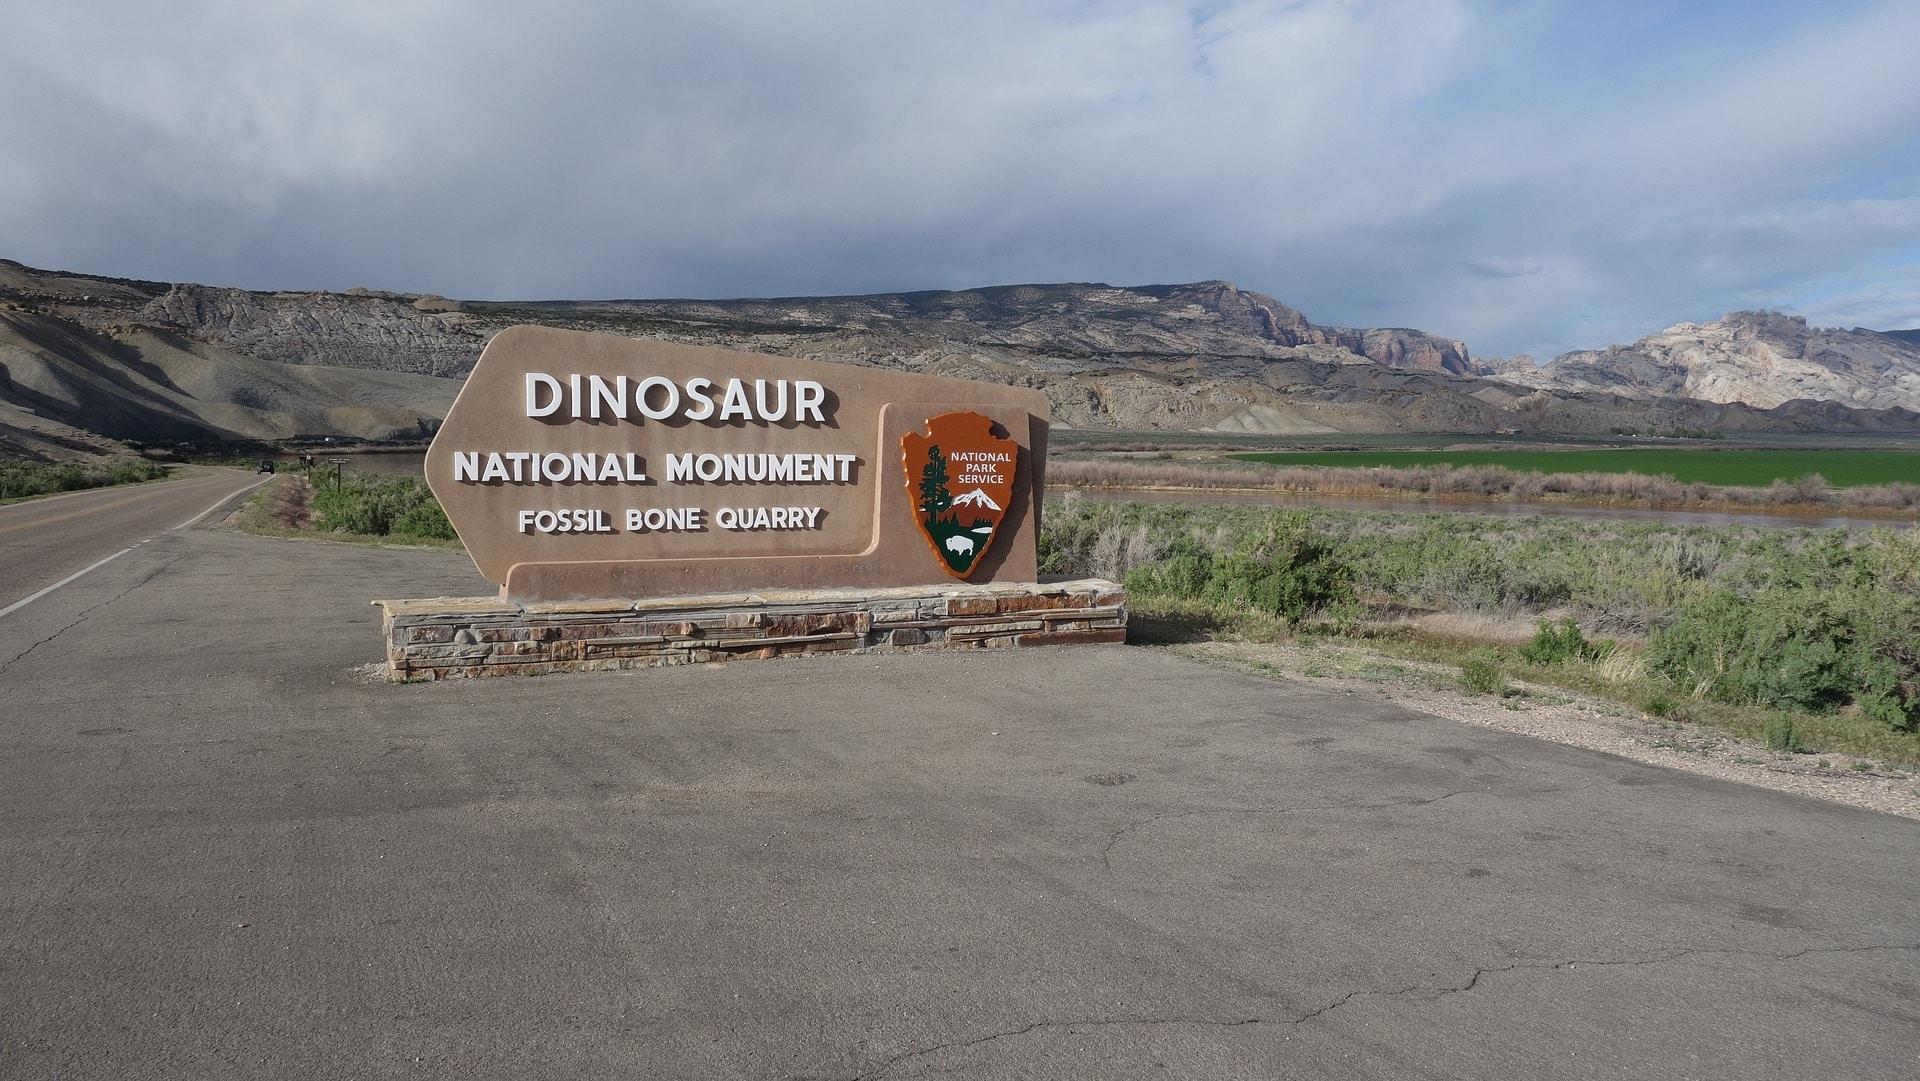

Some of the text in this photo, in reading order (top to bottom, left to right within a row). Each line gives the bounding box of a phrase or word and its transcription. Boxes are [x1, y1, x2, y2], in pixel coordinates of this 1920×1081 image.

[525, 372, 826, 422] DINOSAUR
[950, 451, 1012, 462] NATIONAL
[454, 451, 856, 482] NATIONAL MONUMENT
[966, 463, 997, 473] PARK
[958, 474, 1004, 484] SERVICE
[519, 506, 821, 533] FOSSIL BONE QUARRY
